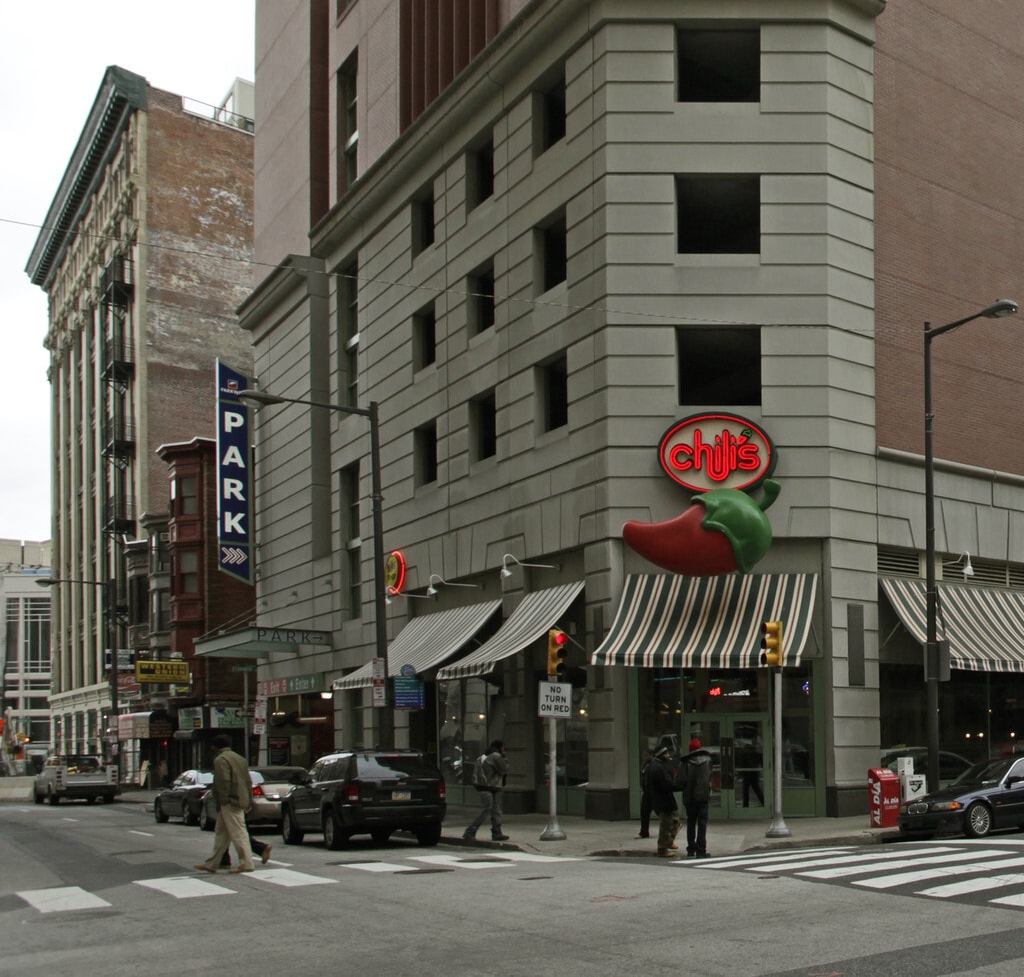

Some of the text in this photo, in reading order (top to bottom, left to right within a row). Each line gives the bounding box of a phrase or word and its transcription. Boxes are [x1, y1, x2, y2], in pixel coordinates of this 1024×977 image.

[669, 429, 761, 482] chili's
[222, 411, 246, 535] PARK
[257, 628, 311, 643] PARK
[295, 678, 310, 691] Enter
[550, 685, 562, 694] NO
[545, 694, 567, 703] TURN
[541, 704, 570, 713] ON RED
[873, 808, 881, 825] AL
